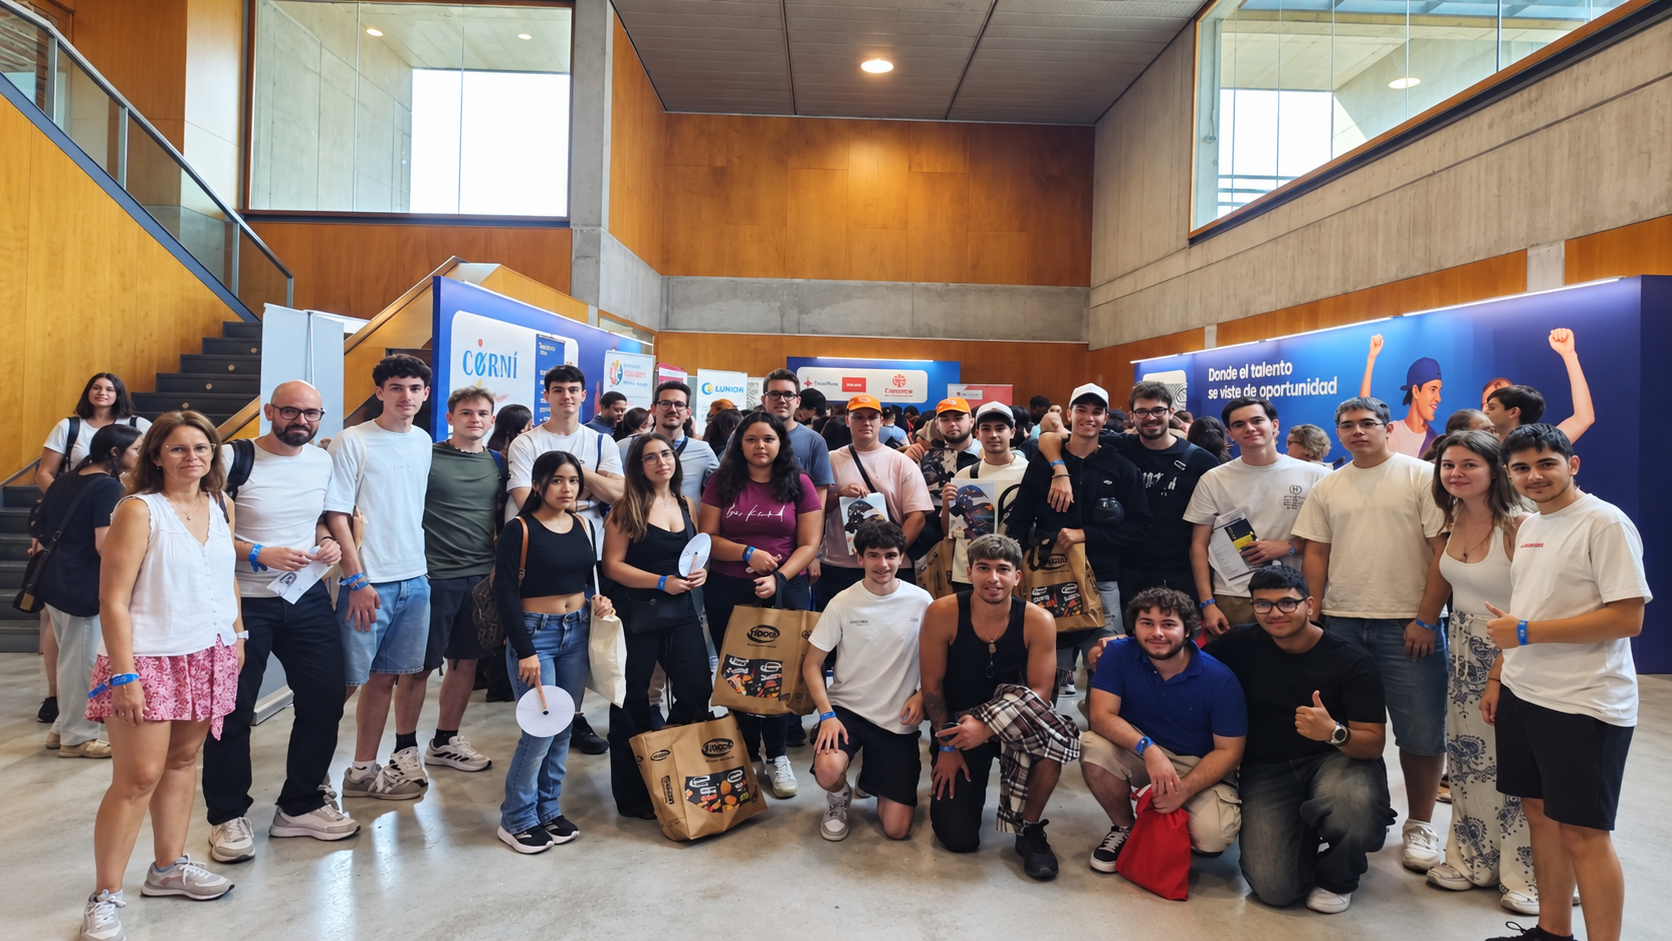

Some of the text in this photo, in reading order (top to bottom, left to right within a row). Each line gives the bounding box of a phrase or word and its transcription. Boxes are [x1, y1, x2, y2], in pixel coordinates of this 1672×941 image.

[1208, 360, 1293, 381] Donde el talento
[1207, 376, 1338, 400] se viste de oportunidad
